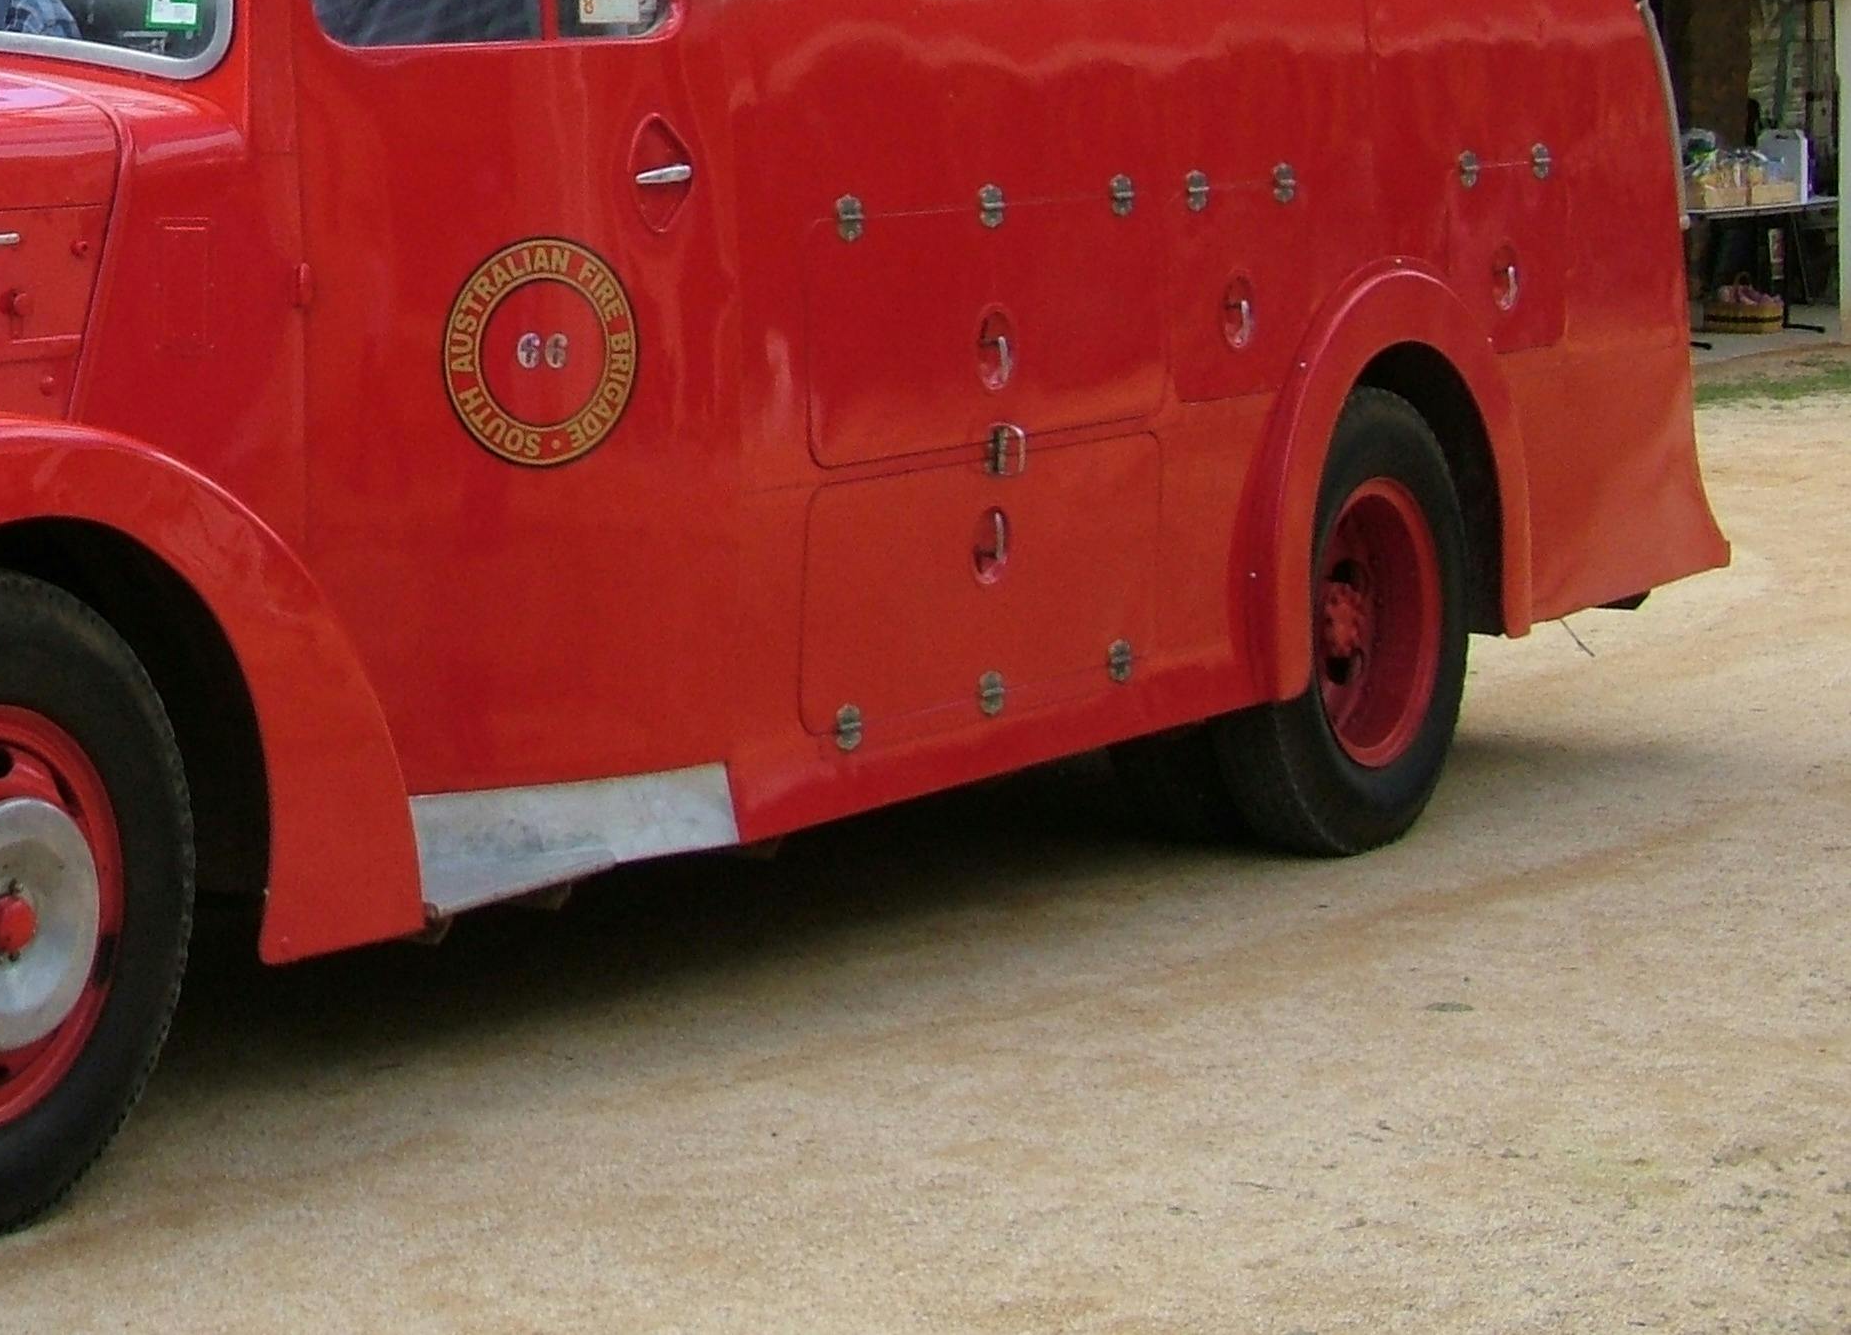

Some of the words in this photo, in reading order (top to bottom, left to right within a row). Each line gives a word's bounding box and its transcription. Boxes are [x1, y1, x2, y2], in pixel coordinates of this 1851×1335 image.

[450, 246, 571, 374] AUSTRALIAN
[577, 259, 624, 323] FIRE
[458, 386, 541, 457] SOUTH
[566, 331, 631, 449] BRIGADE
